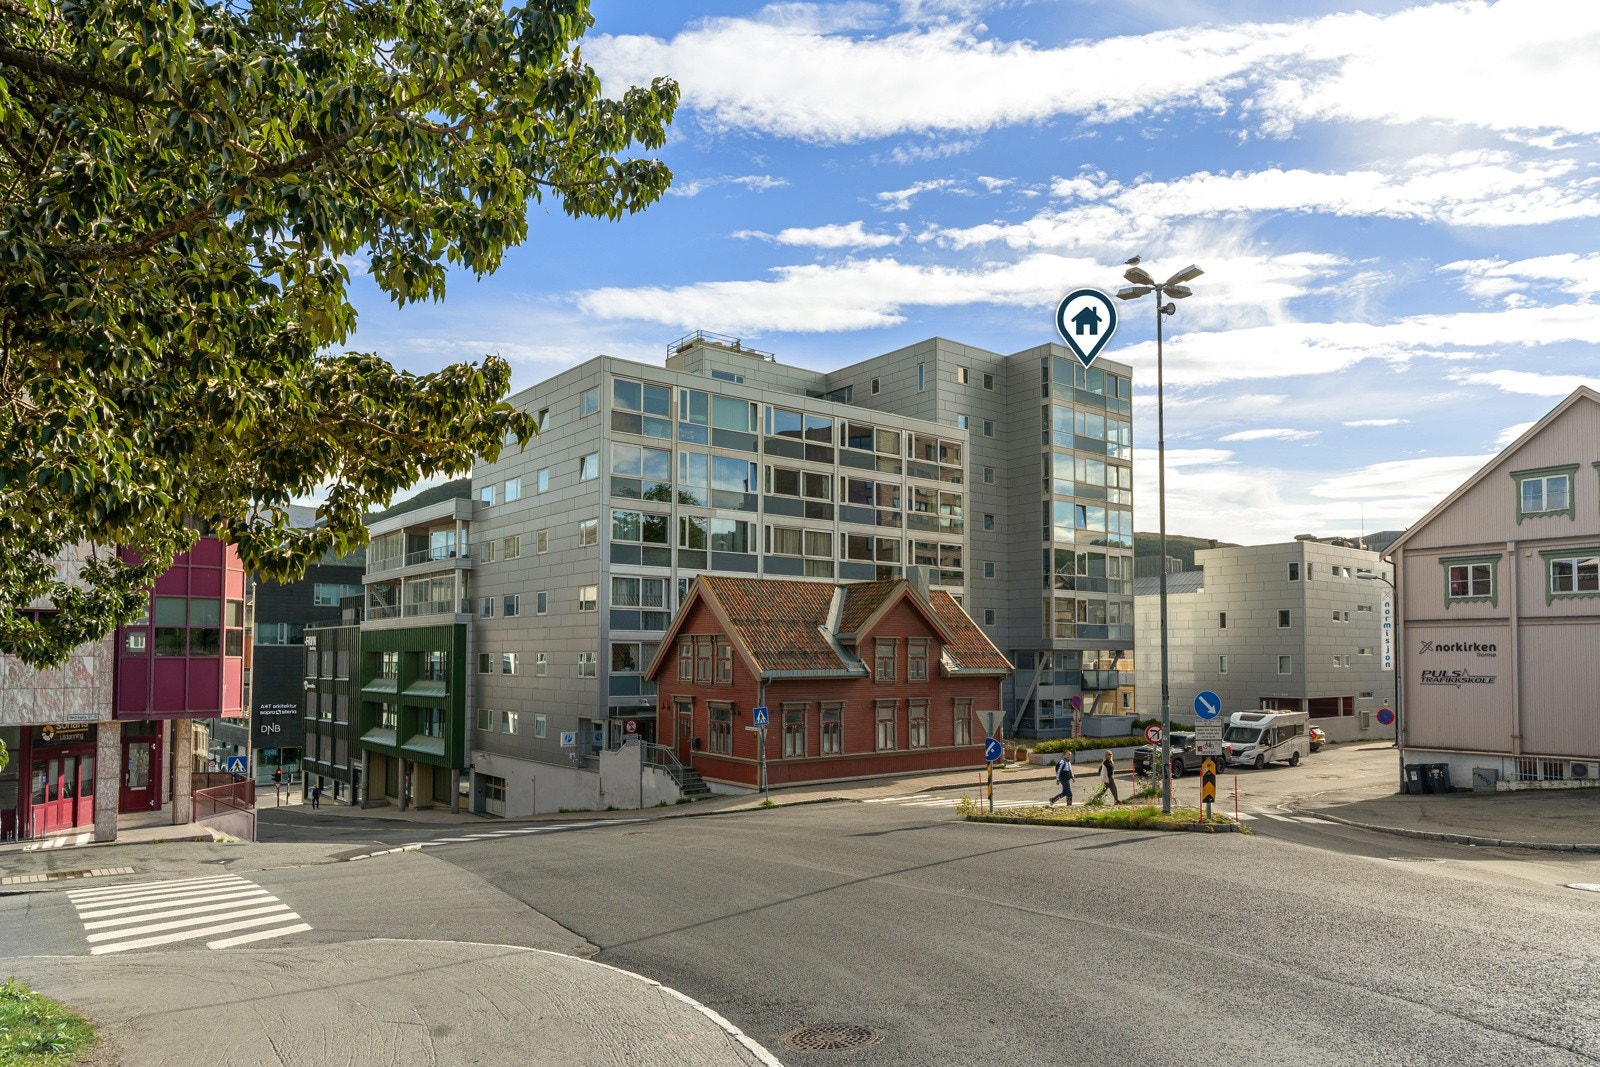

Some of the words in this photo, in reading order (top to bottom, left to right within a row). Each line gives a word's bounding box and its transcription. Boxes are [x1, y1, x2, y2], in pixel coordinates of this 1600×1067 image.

[1383, 602, 1391, 668] normisjon
[1435, 642, 1497, 652] norkirken
[260, 722, 281, 735] DNB
